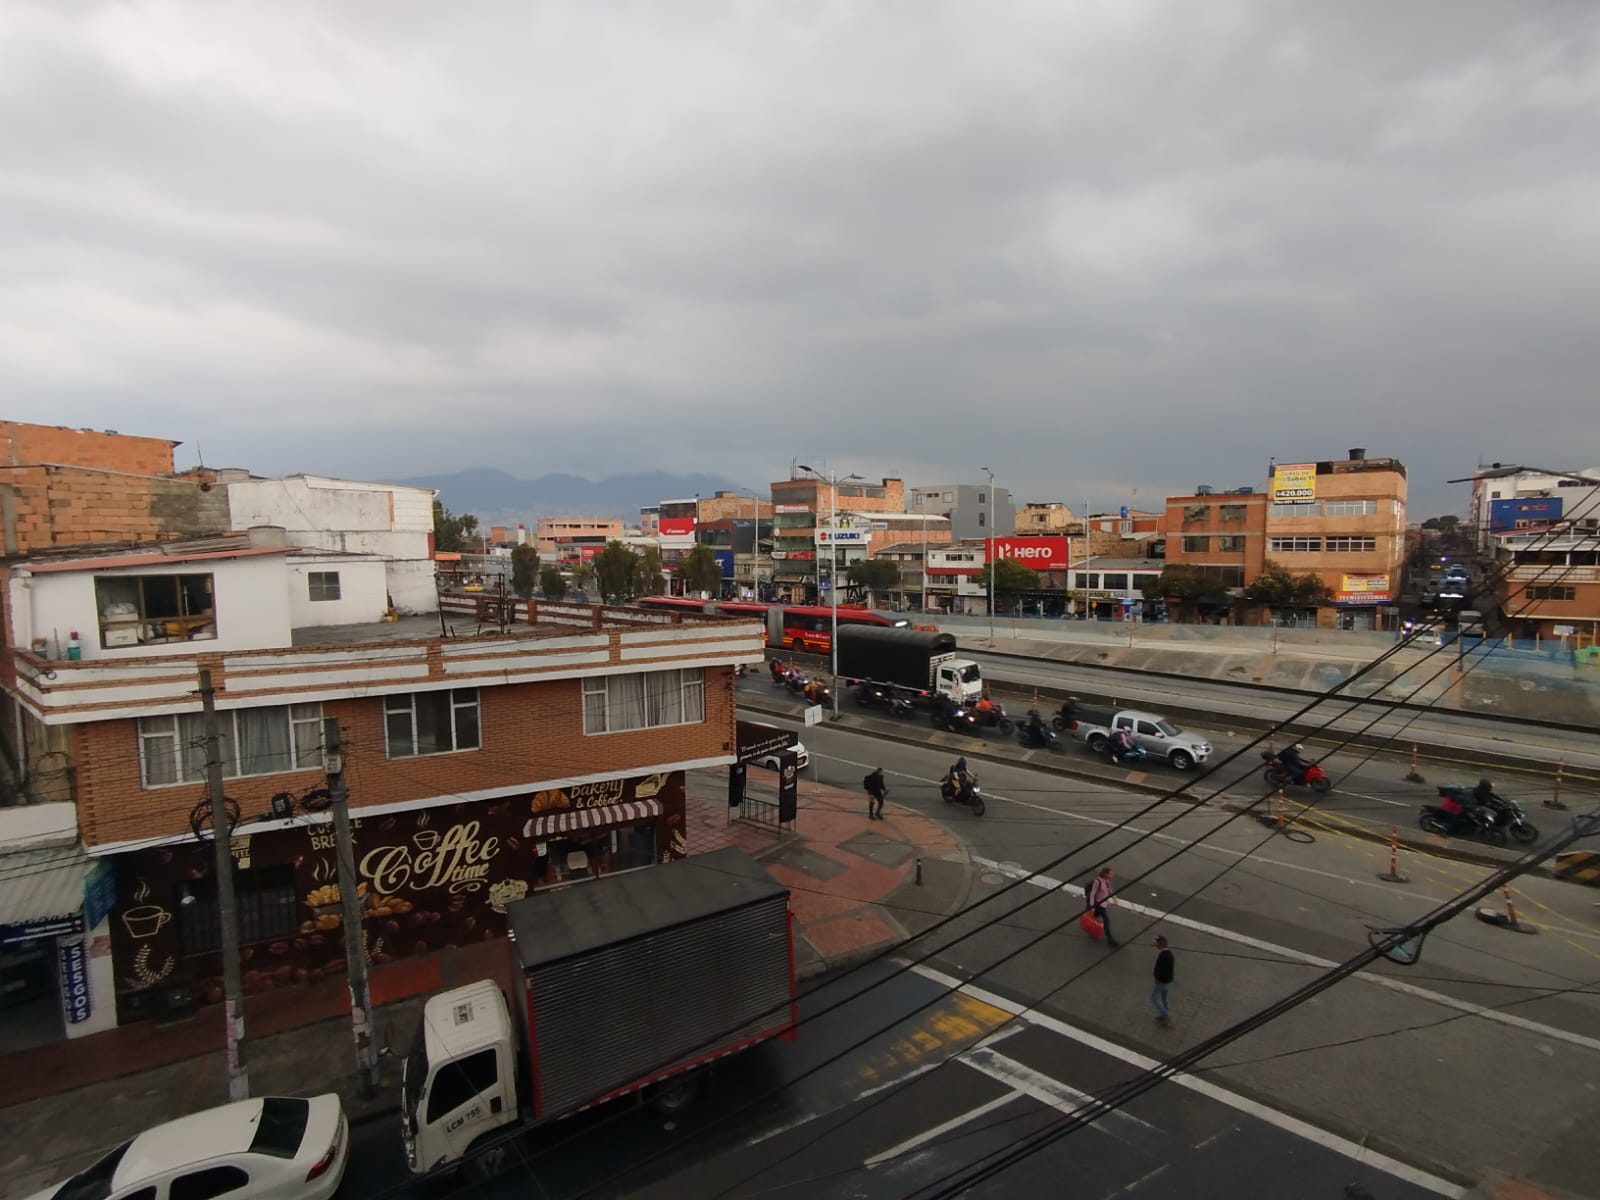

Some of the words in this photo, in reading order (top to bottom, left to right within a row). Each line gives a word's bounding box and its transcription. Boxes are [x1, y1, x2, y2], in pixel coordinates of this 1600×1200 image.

[360, 820, 500, 895] Coffee
[451, 863, 490, 882] time
[71, 946, 87, 1020] SESGOS
[446, 1117, 464, 1133] LCM
